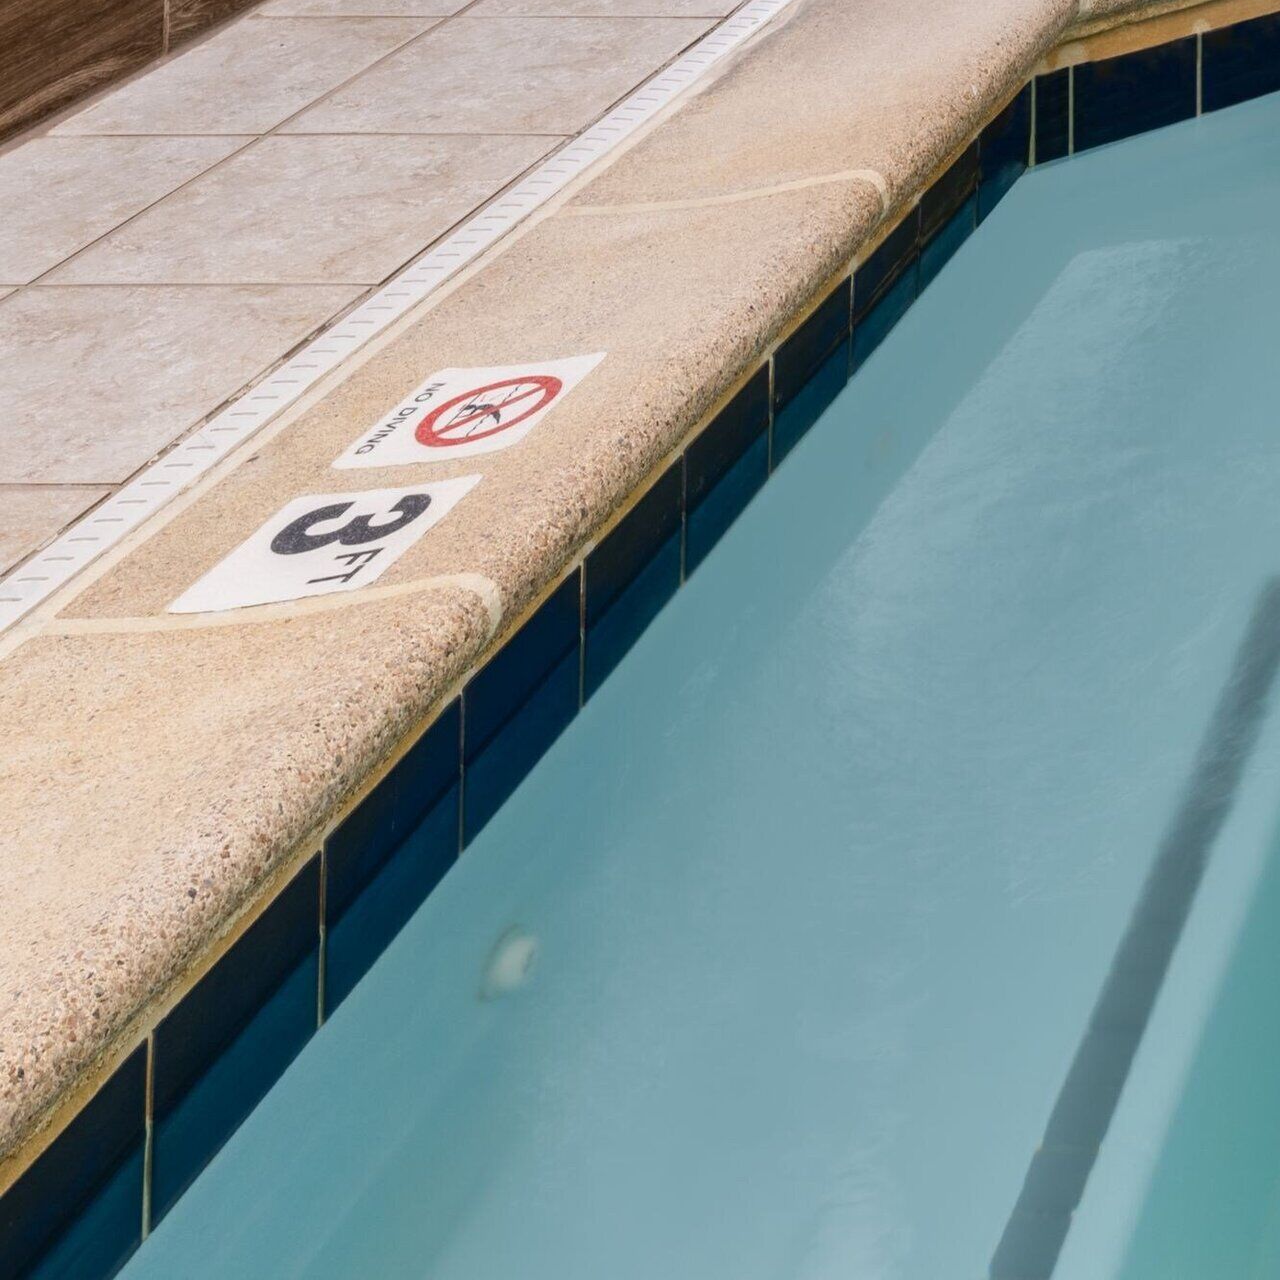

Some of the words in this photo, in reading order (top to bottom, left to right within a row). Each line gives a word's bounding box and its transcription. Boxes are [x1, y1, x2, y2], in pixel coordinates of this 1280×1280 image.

[414, 382, 446, 403] NO
[354, 407, 419, 456] DIVING
[269, 493, 432, 555] 3
[306, 546, 387, 585] FT
